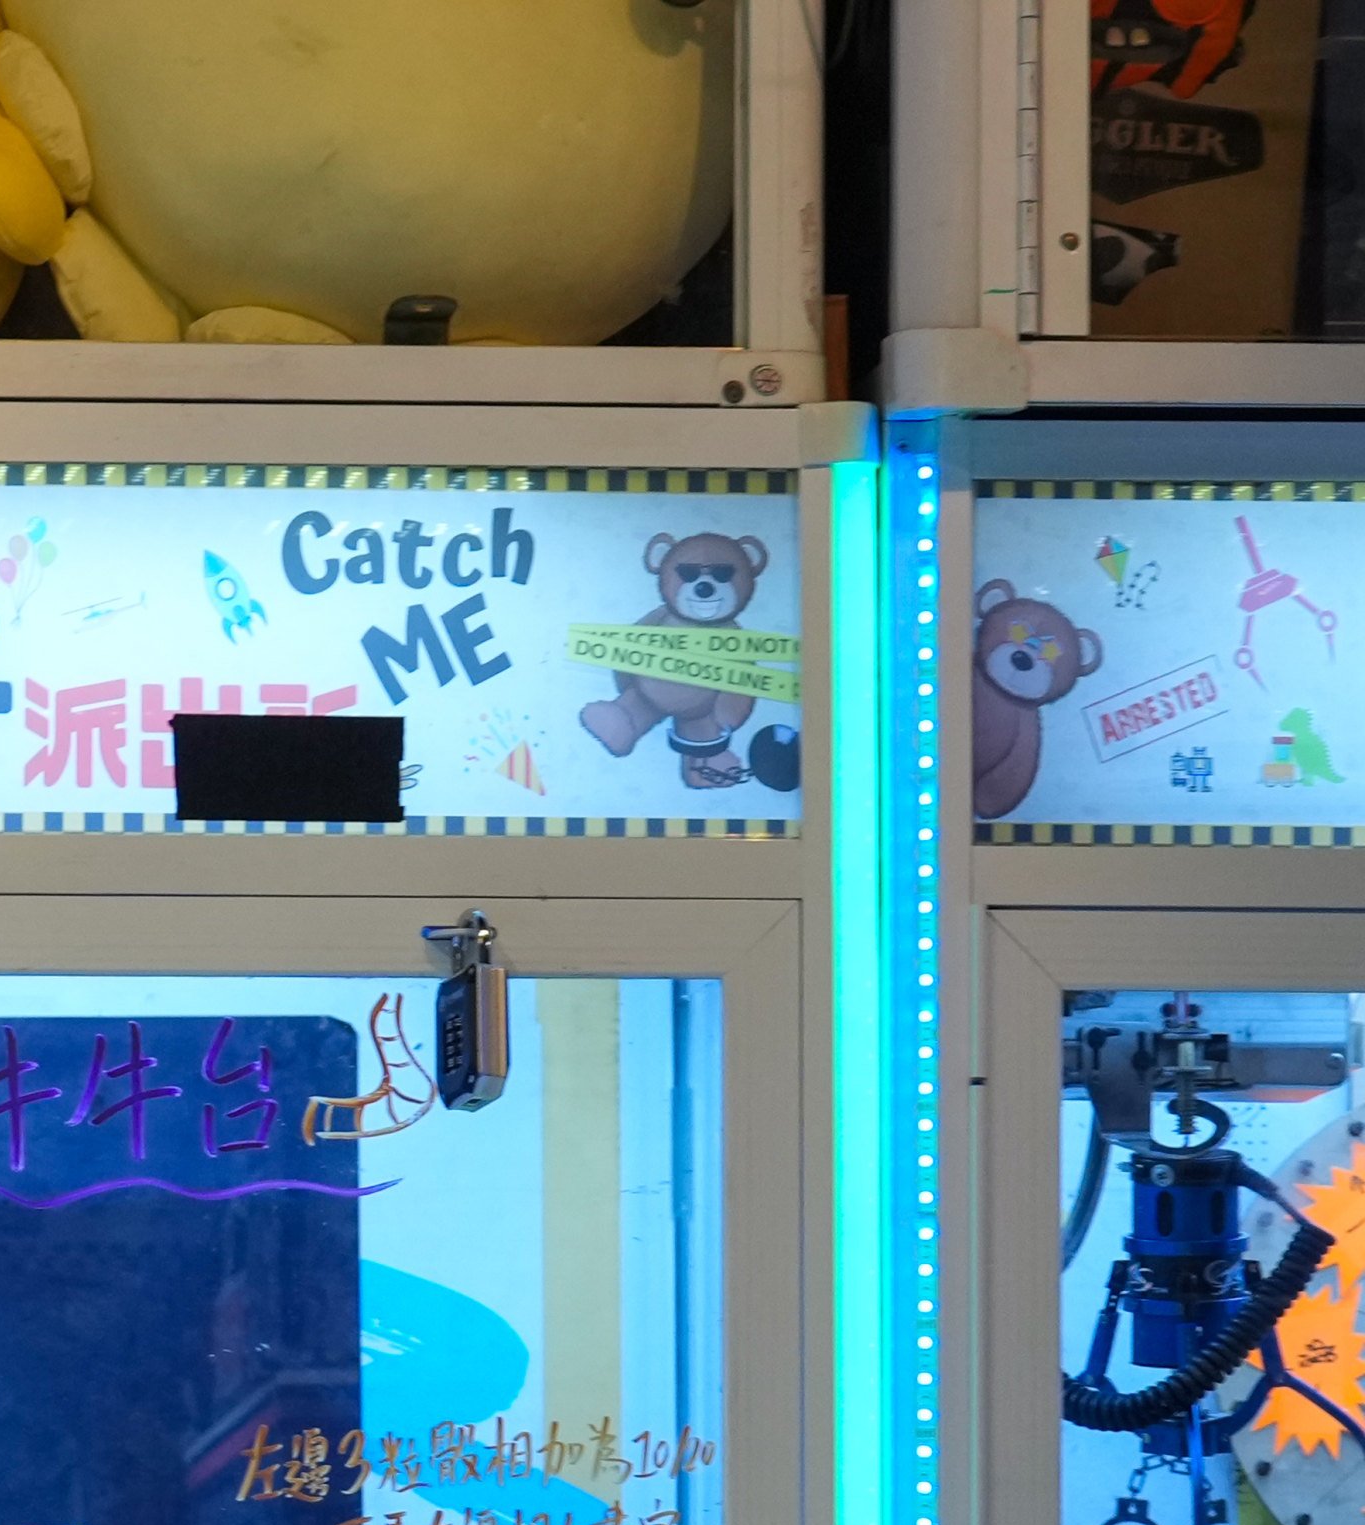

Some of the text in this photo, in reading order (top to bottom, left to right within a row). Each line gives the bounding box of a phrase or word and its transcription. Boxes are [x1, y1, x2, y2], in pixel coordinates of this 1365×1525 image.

[281, 508, 536, 595] Catch
[360, 592, 513, 706] ME
[575, 640, 773, 691] DO NOT CROSS LINE
[708, 635, 741, 652] DO
[746, 637, 788, 654] NOT
[1100, 671, 1218, 745] ARRESTED
